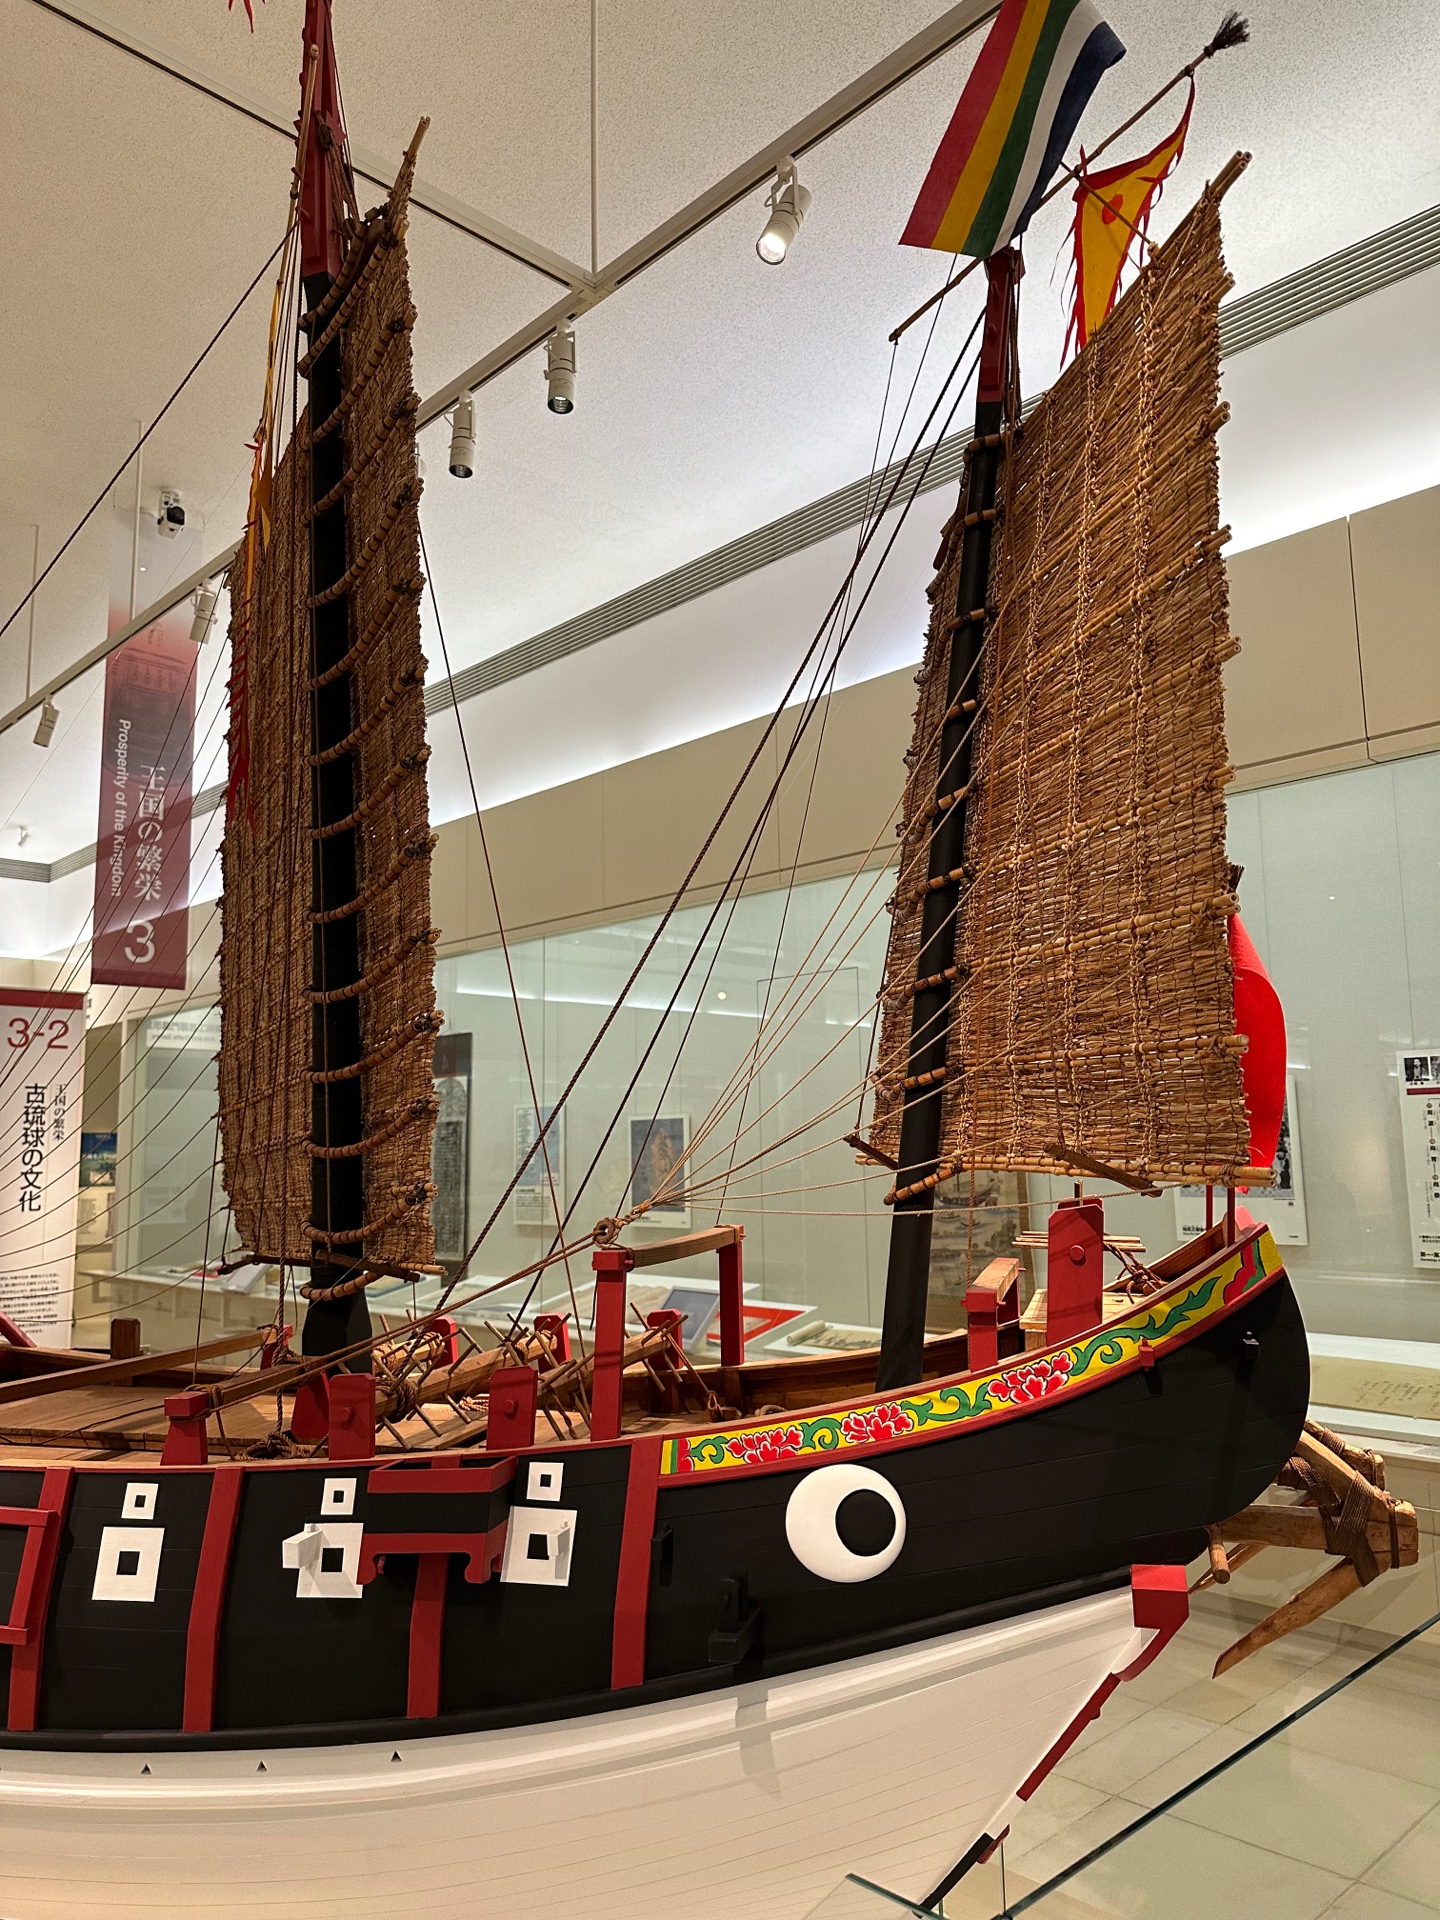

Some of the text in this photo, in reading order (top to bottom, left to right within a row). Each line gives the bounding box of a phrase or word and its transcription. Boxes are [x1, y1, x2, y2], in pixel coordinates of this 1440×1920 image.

[109, 719, 131, 897] Prosperity of the Kingdom
[134, 764, 166, 901] 王国の繁栄
[125, 920, 155, 963] 3
[6, 1017, 70, 1050] 3-2
[19, 1083, 47, 1212] 古琉球の文化
[52, 1083, 67, 1142] 王国の繁栄
